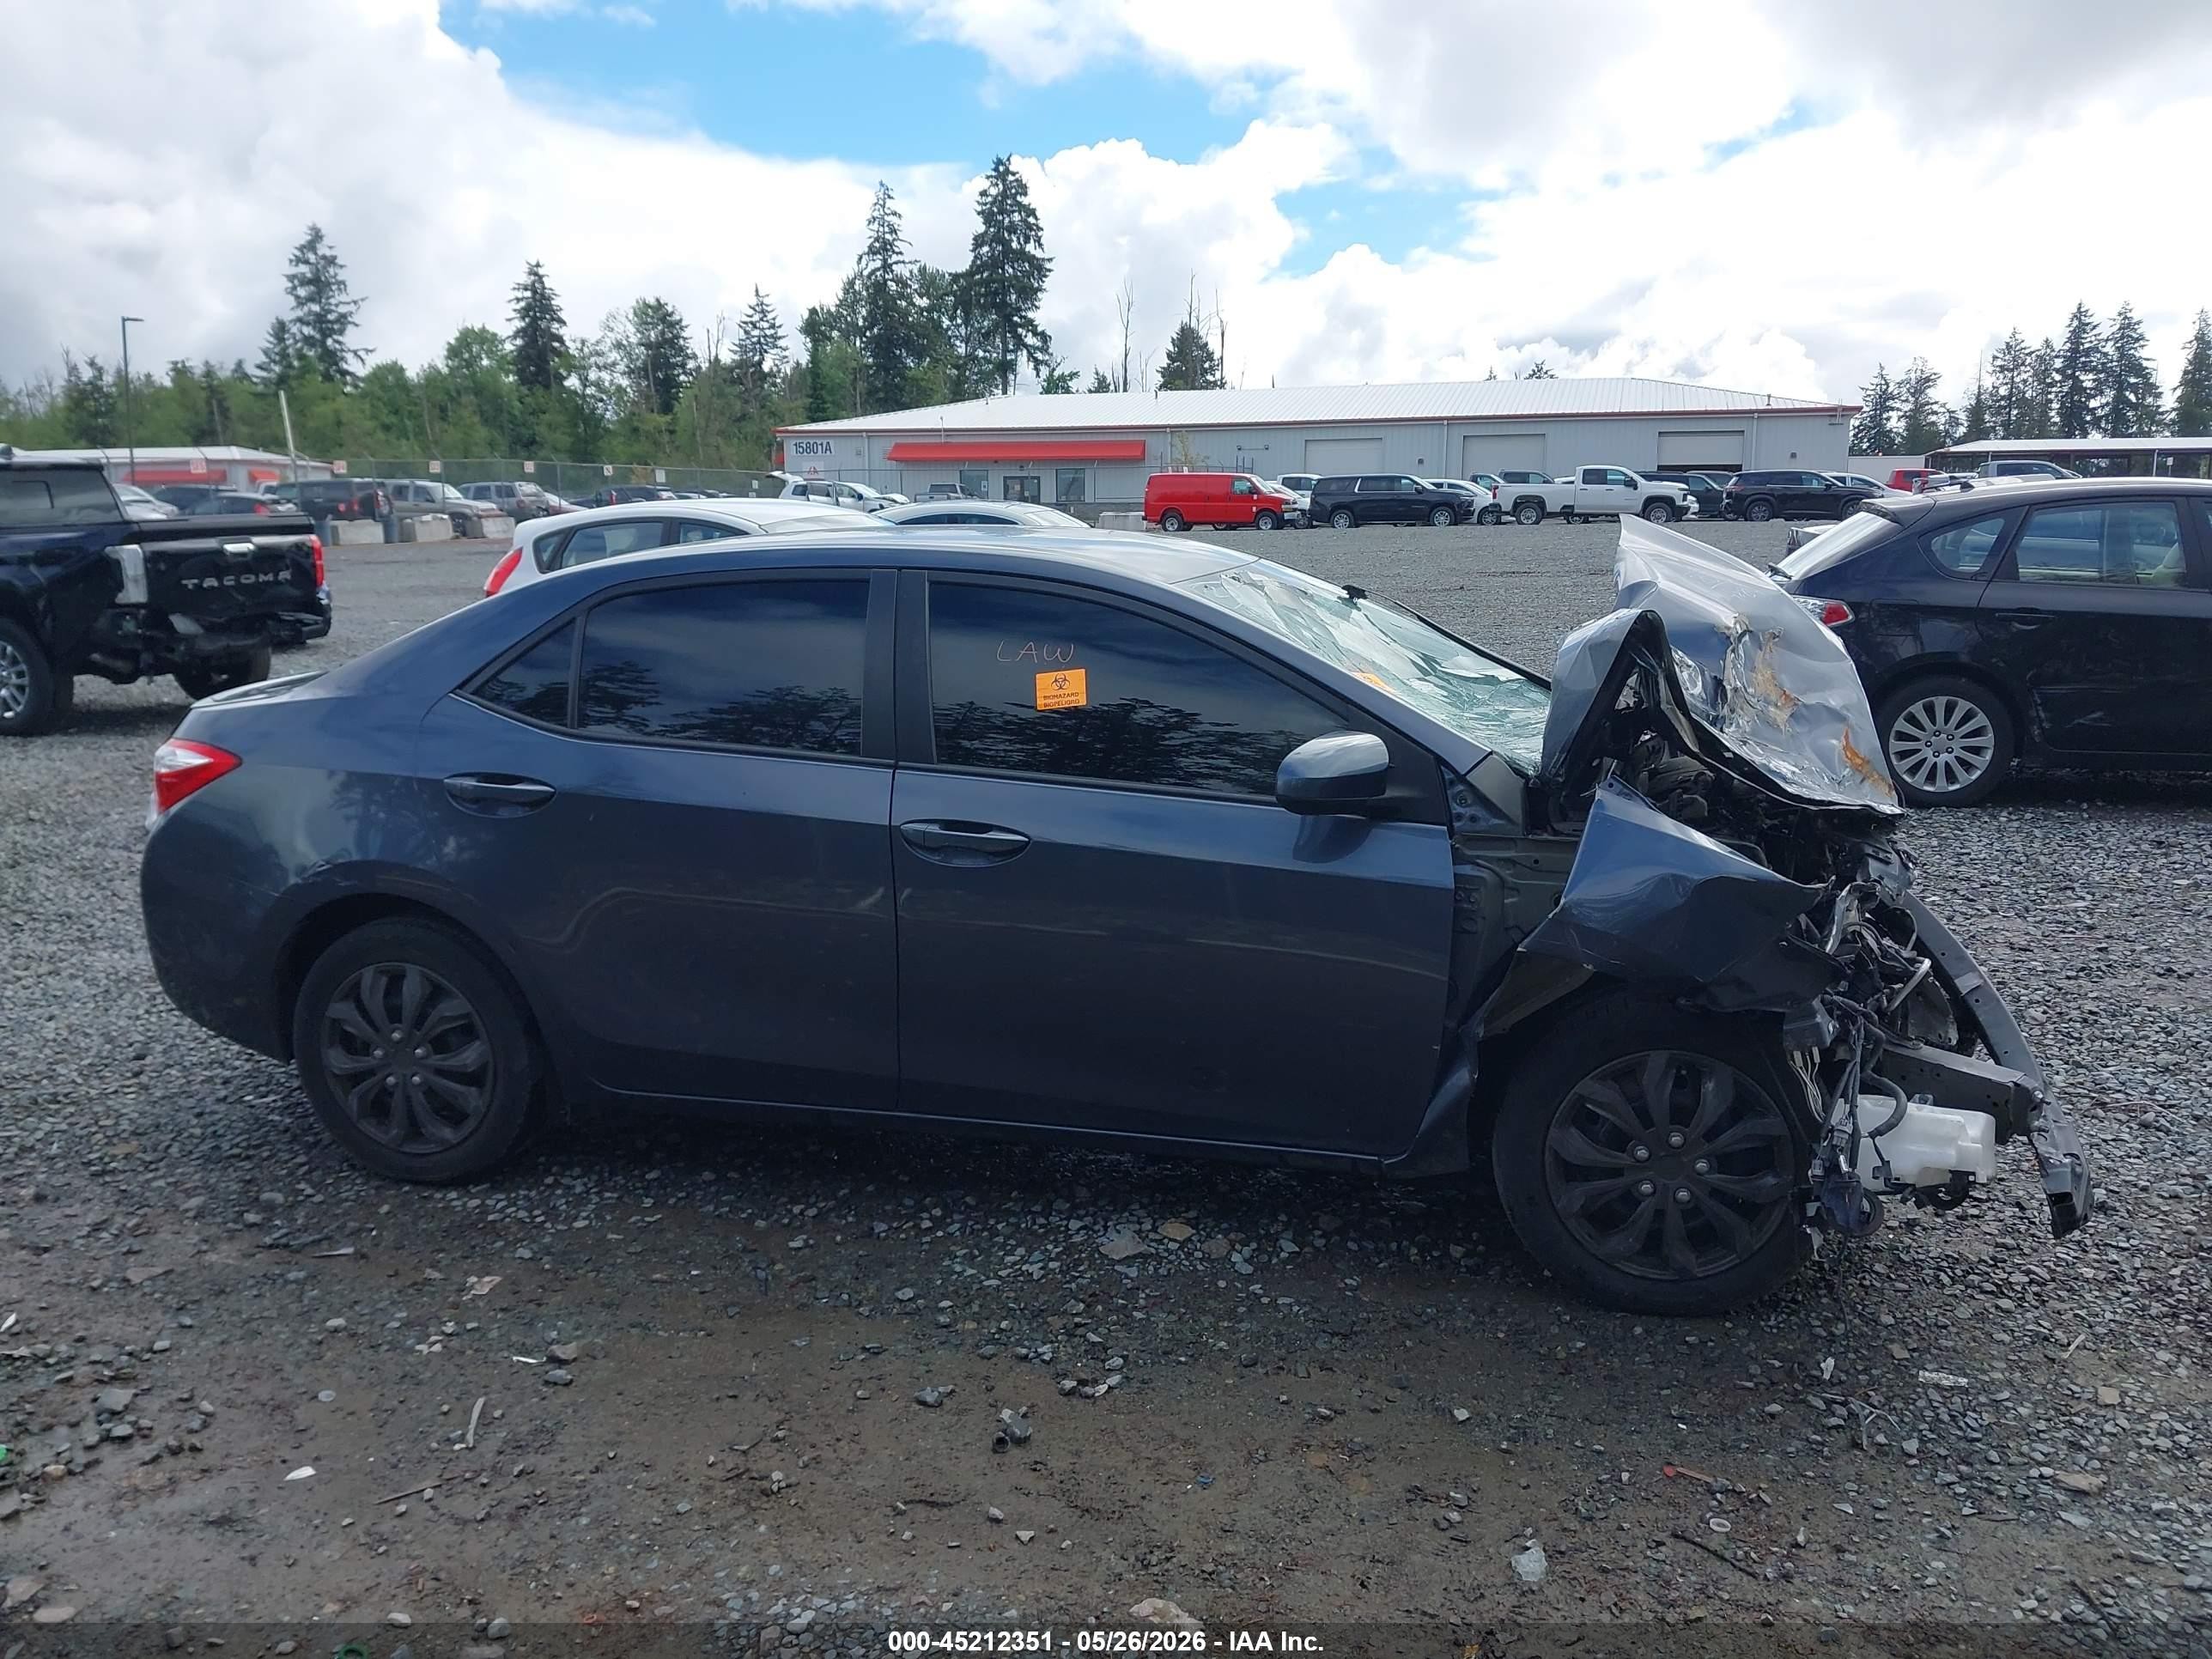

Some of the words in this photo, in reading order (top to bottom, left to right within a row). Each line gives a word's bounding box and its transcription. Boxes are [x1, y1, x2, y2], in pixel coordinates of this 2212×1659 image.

[793, 441, 832, 454] 15801A
[180, 569, 292, 589] TACOMA
[996, 639, 1074, 663] LAW
[1043, 692, 1079, 701] BIOHAZARD
[1043, 699, 1080, 708] BIOPELIGRO
